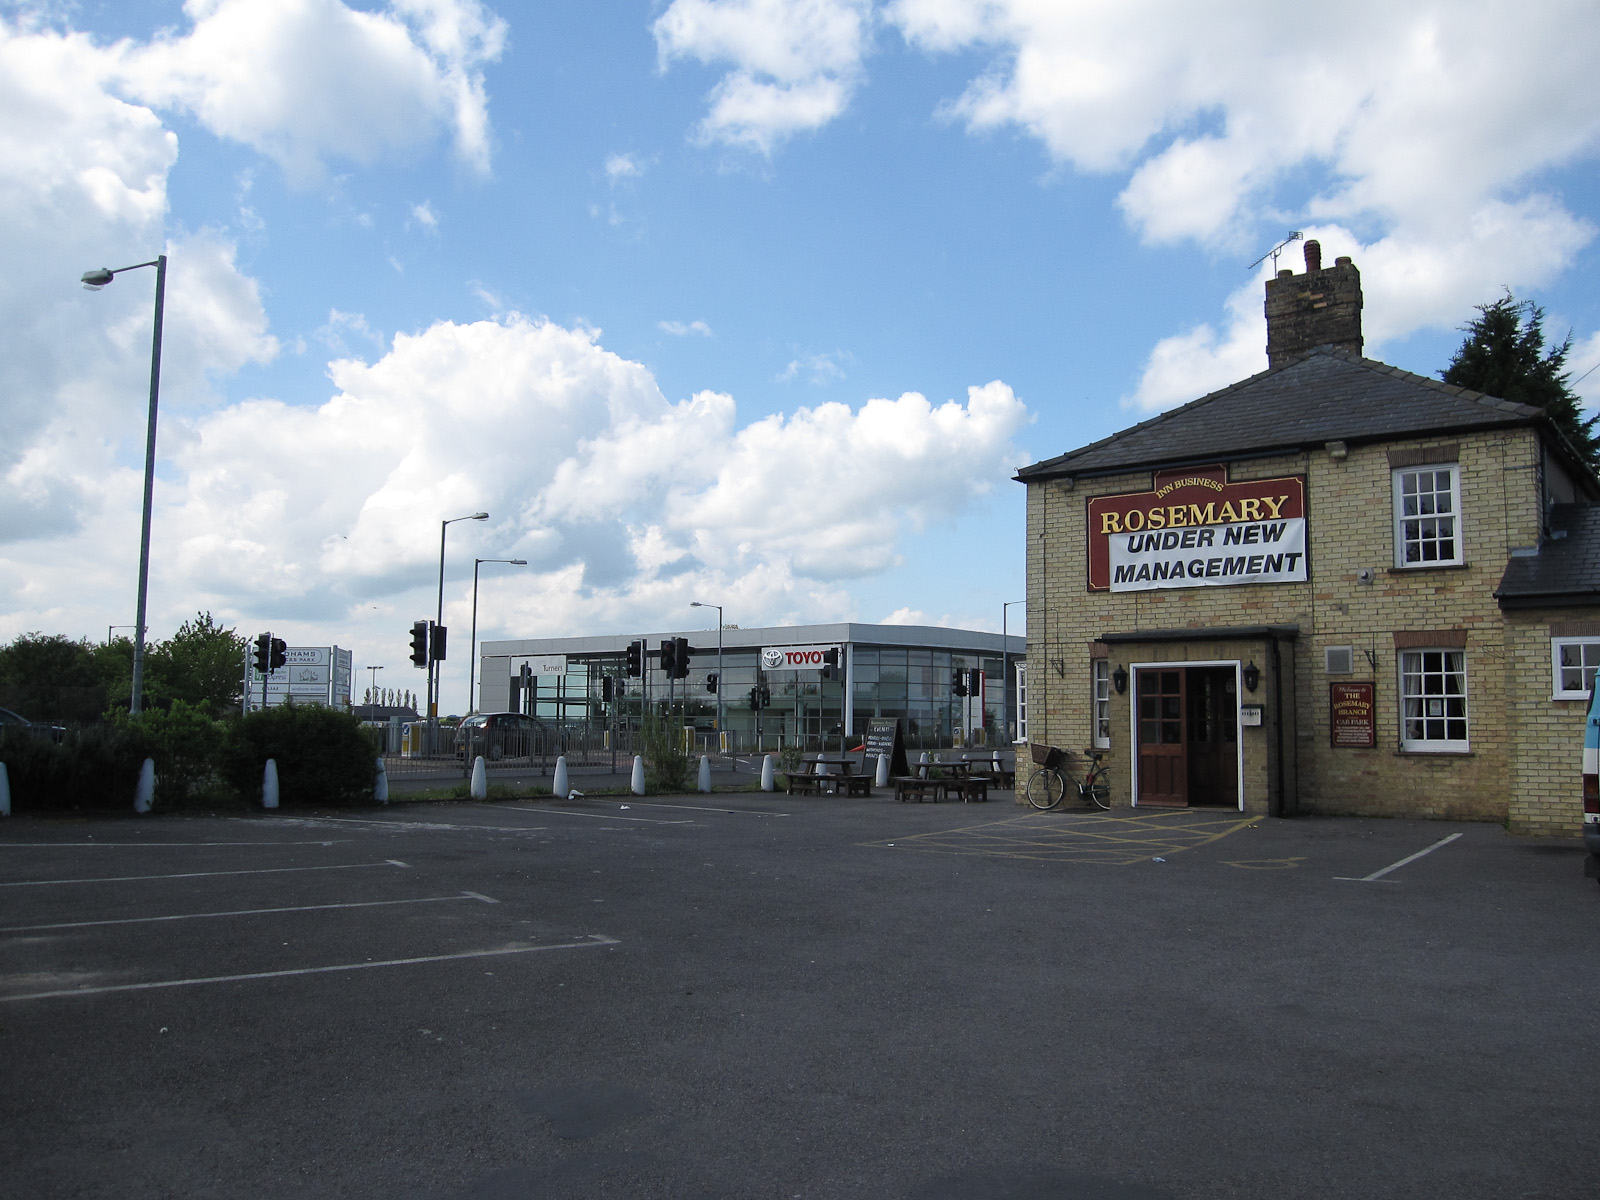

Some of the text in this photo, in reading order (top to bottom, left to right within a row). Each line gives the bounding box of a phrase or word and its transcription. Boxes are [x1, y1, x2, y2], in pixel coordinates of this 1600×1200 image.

[1156, 477, 1224, 499] INN BUSINESS
[1100, 495, 1289, 534] ROSEMARY
[1127, 522, 1287, 553] UNDER NEW
[1114, 552, 1302, 583] MANAGEMENT
[785, 651, 825, 664] TOYO
[1334, 700, 1370, 709] ROSEMARY
